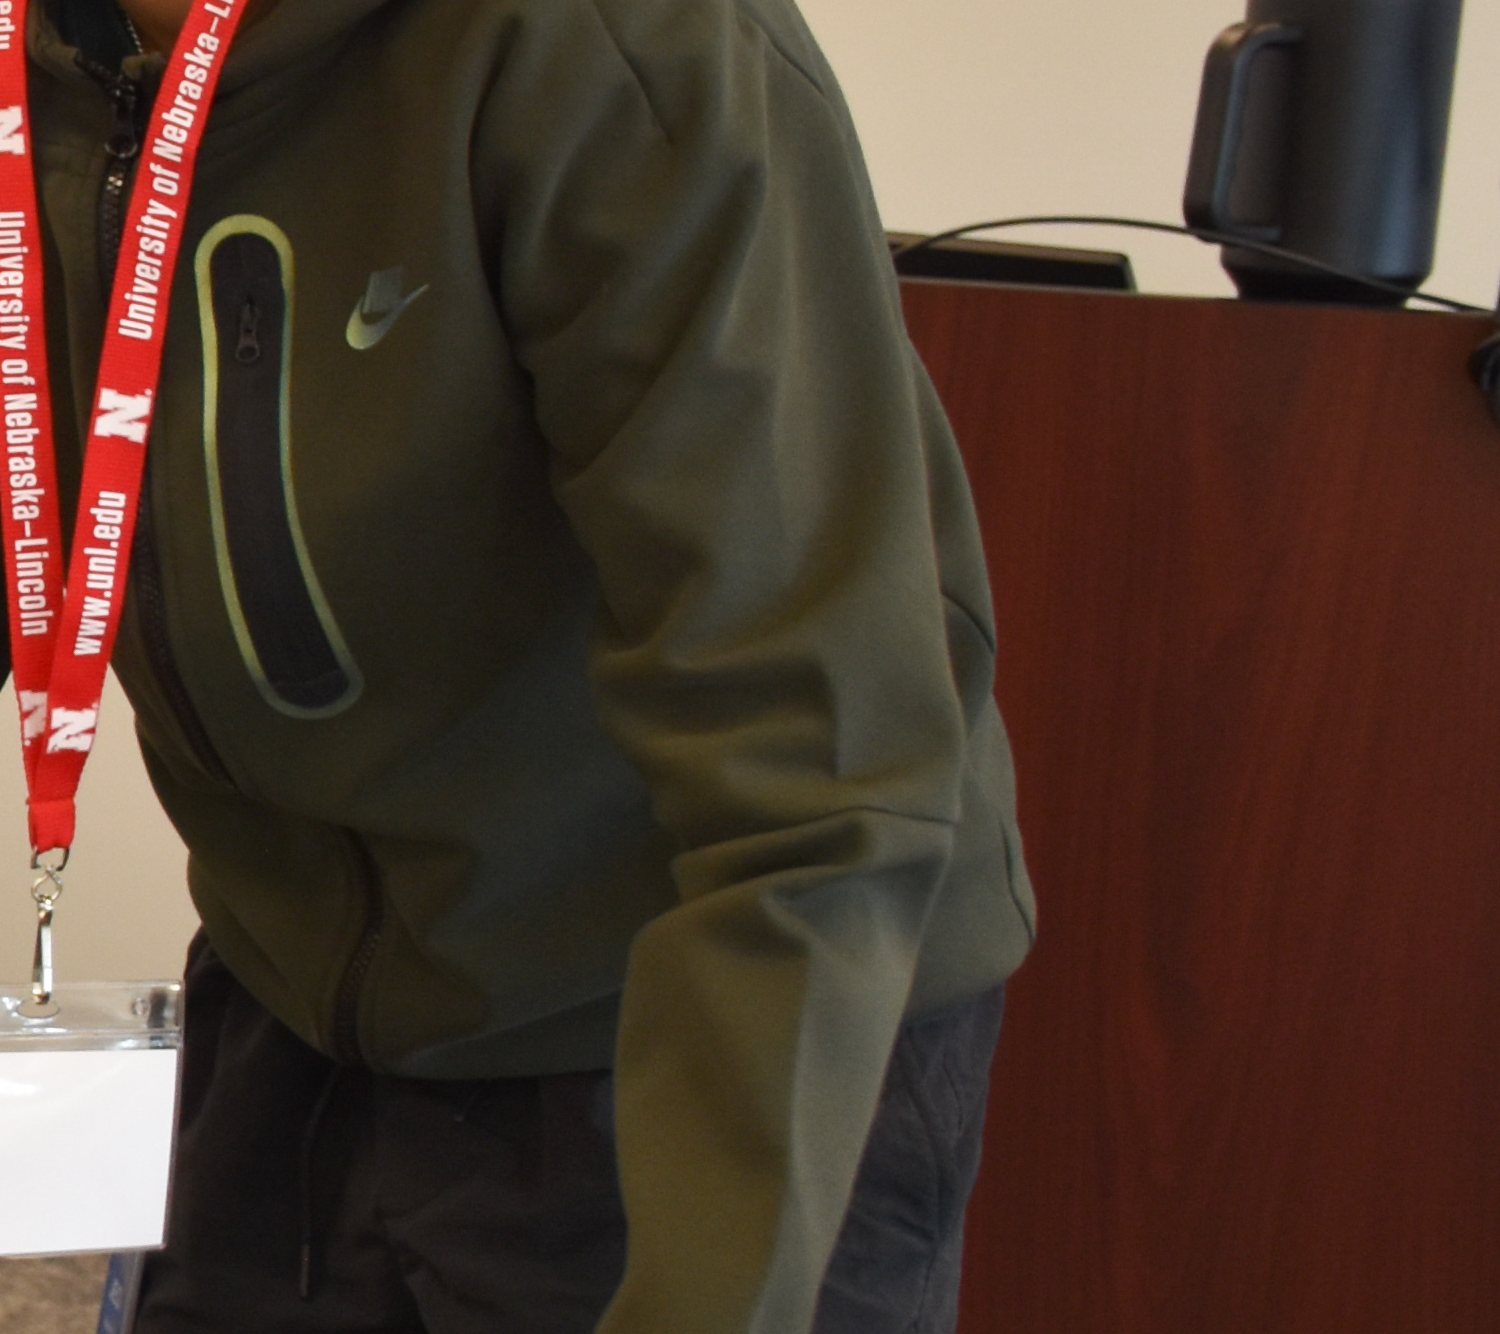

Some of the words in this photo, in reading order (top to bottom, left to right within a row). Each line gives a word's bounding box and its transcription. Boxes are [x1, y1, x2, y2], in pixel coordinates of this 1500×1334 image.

[145, 155, 181, 195] of
[118, 193, 180, 342] University
[0, 352, 32, 390] of
[94, 386, 152, 447] N
[73, 490, 127, 656] www.unl.edu
